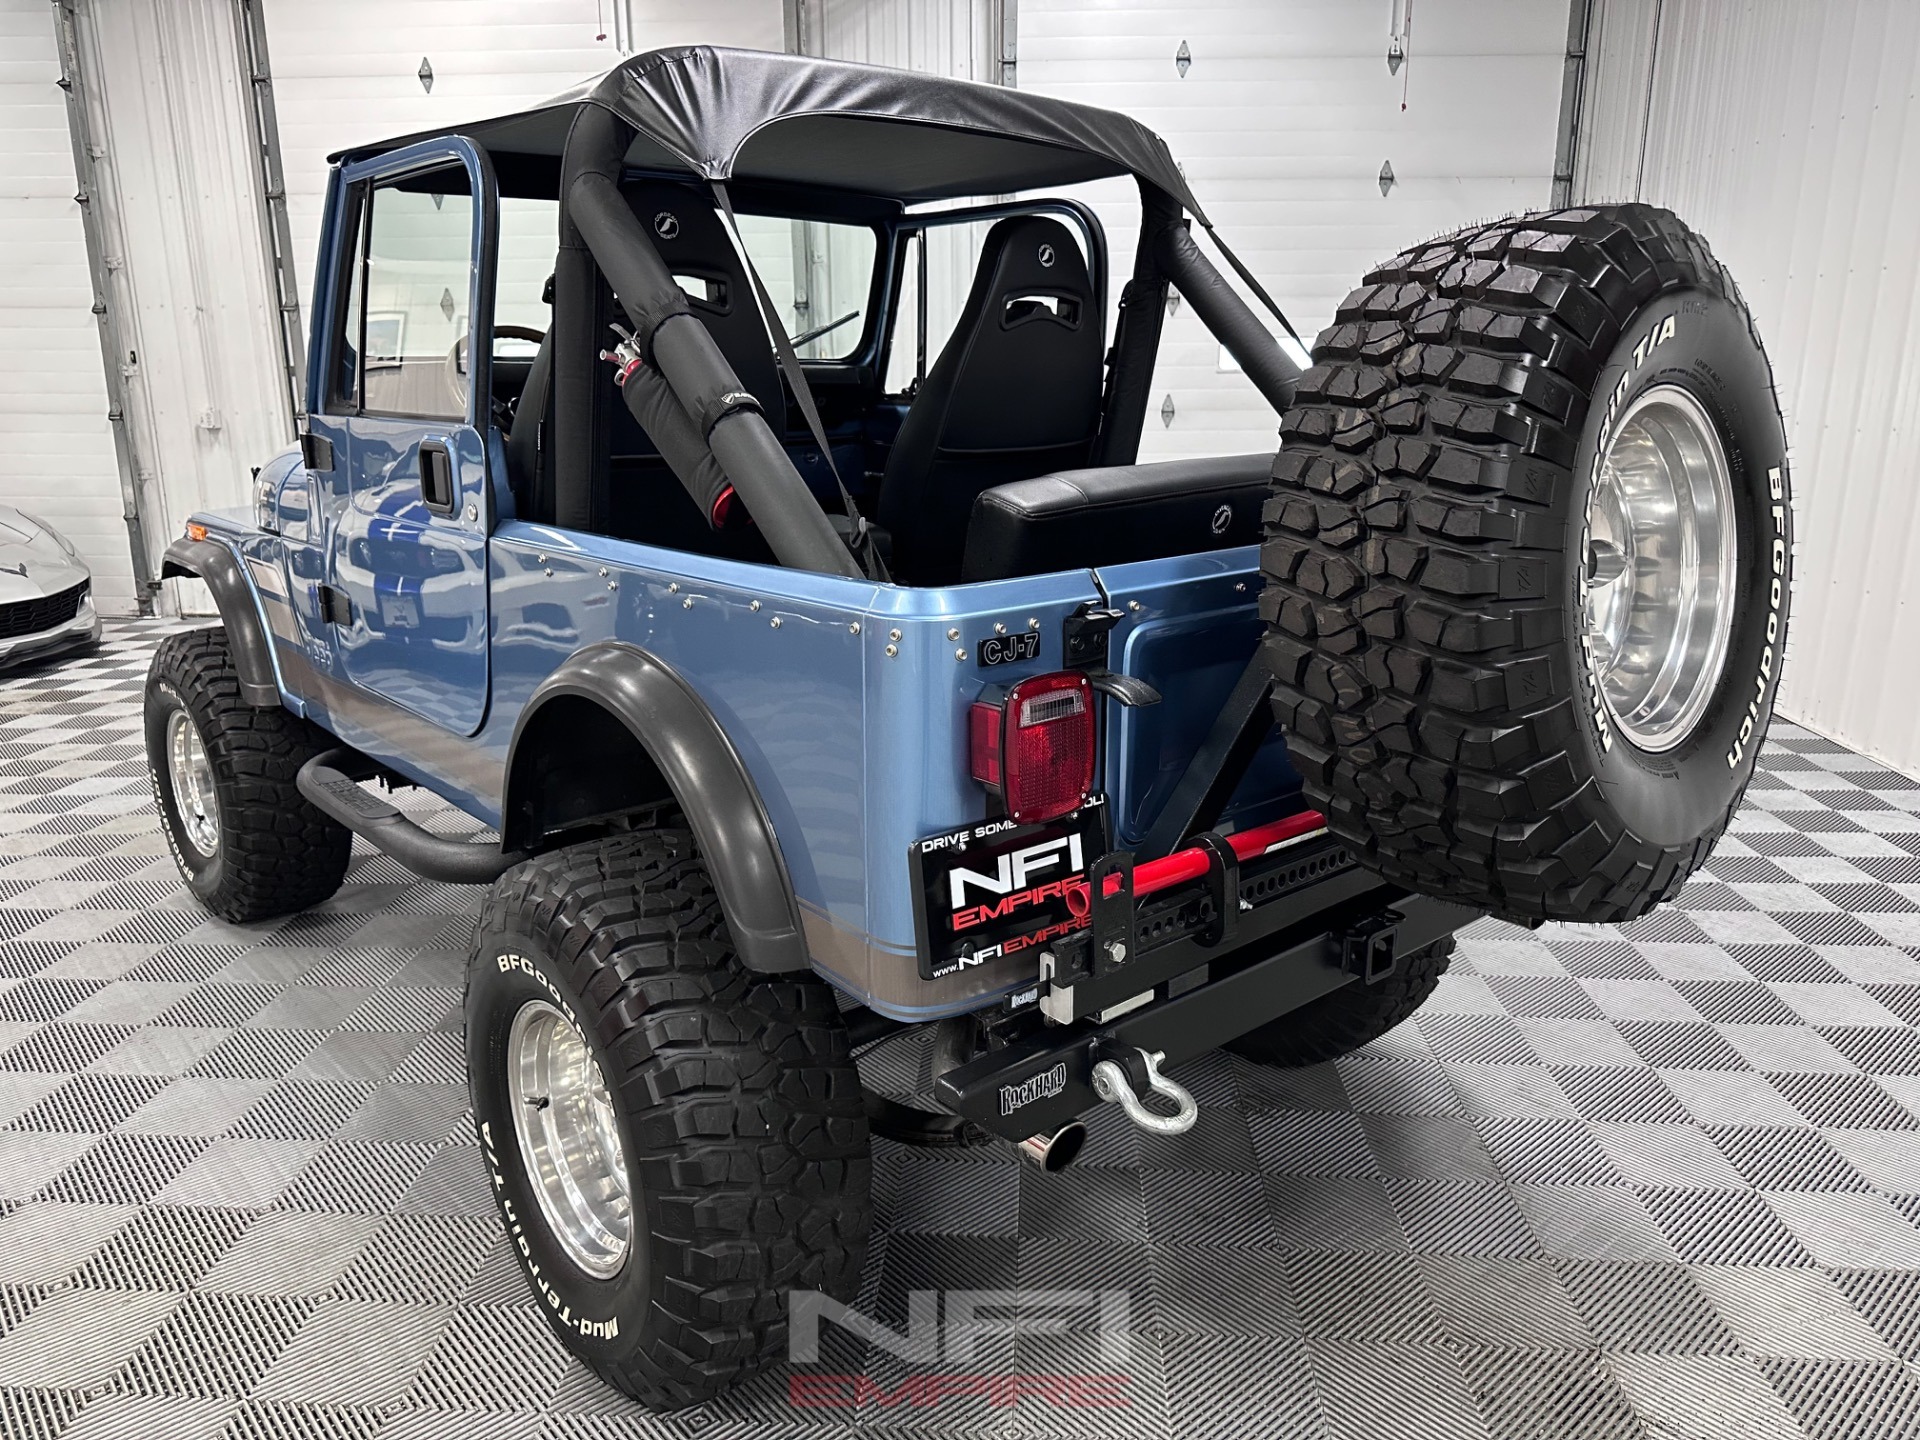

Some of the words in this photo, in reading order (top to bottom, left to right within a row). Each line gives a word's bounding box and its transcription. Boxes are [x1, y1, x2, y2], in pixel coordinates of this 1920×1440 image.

[1632, 313, 1675, 369] T/A
[984, 633, 1039, 665] CJ-7
[1727, 466, 1785, 769] BFGoodrich
[921, 831, 970, 853] DRIVE
[949, 833, 1084, 909] NFI
[952, 873, 1085, 931] EMPIRE
[481, 1121, 505, 1192] T/A
[503, 1199, 620, 1340] Mud-Terrain
